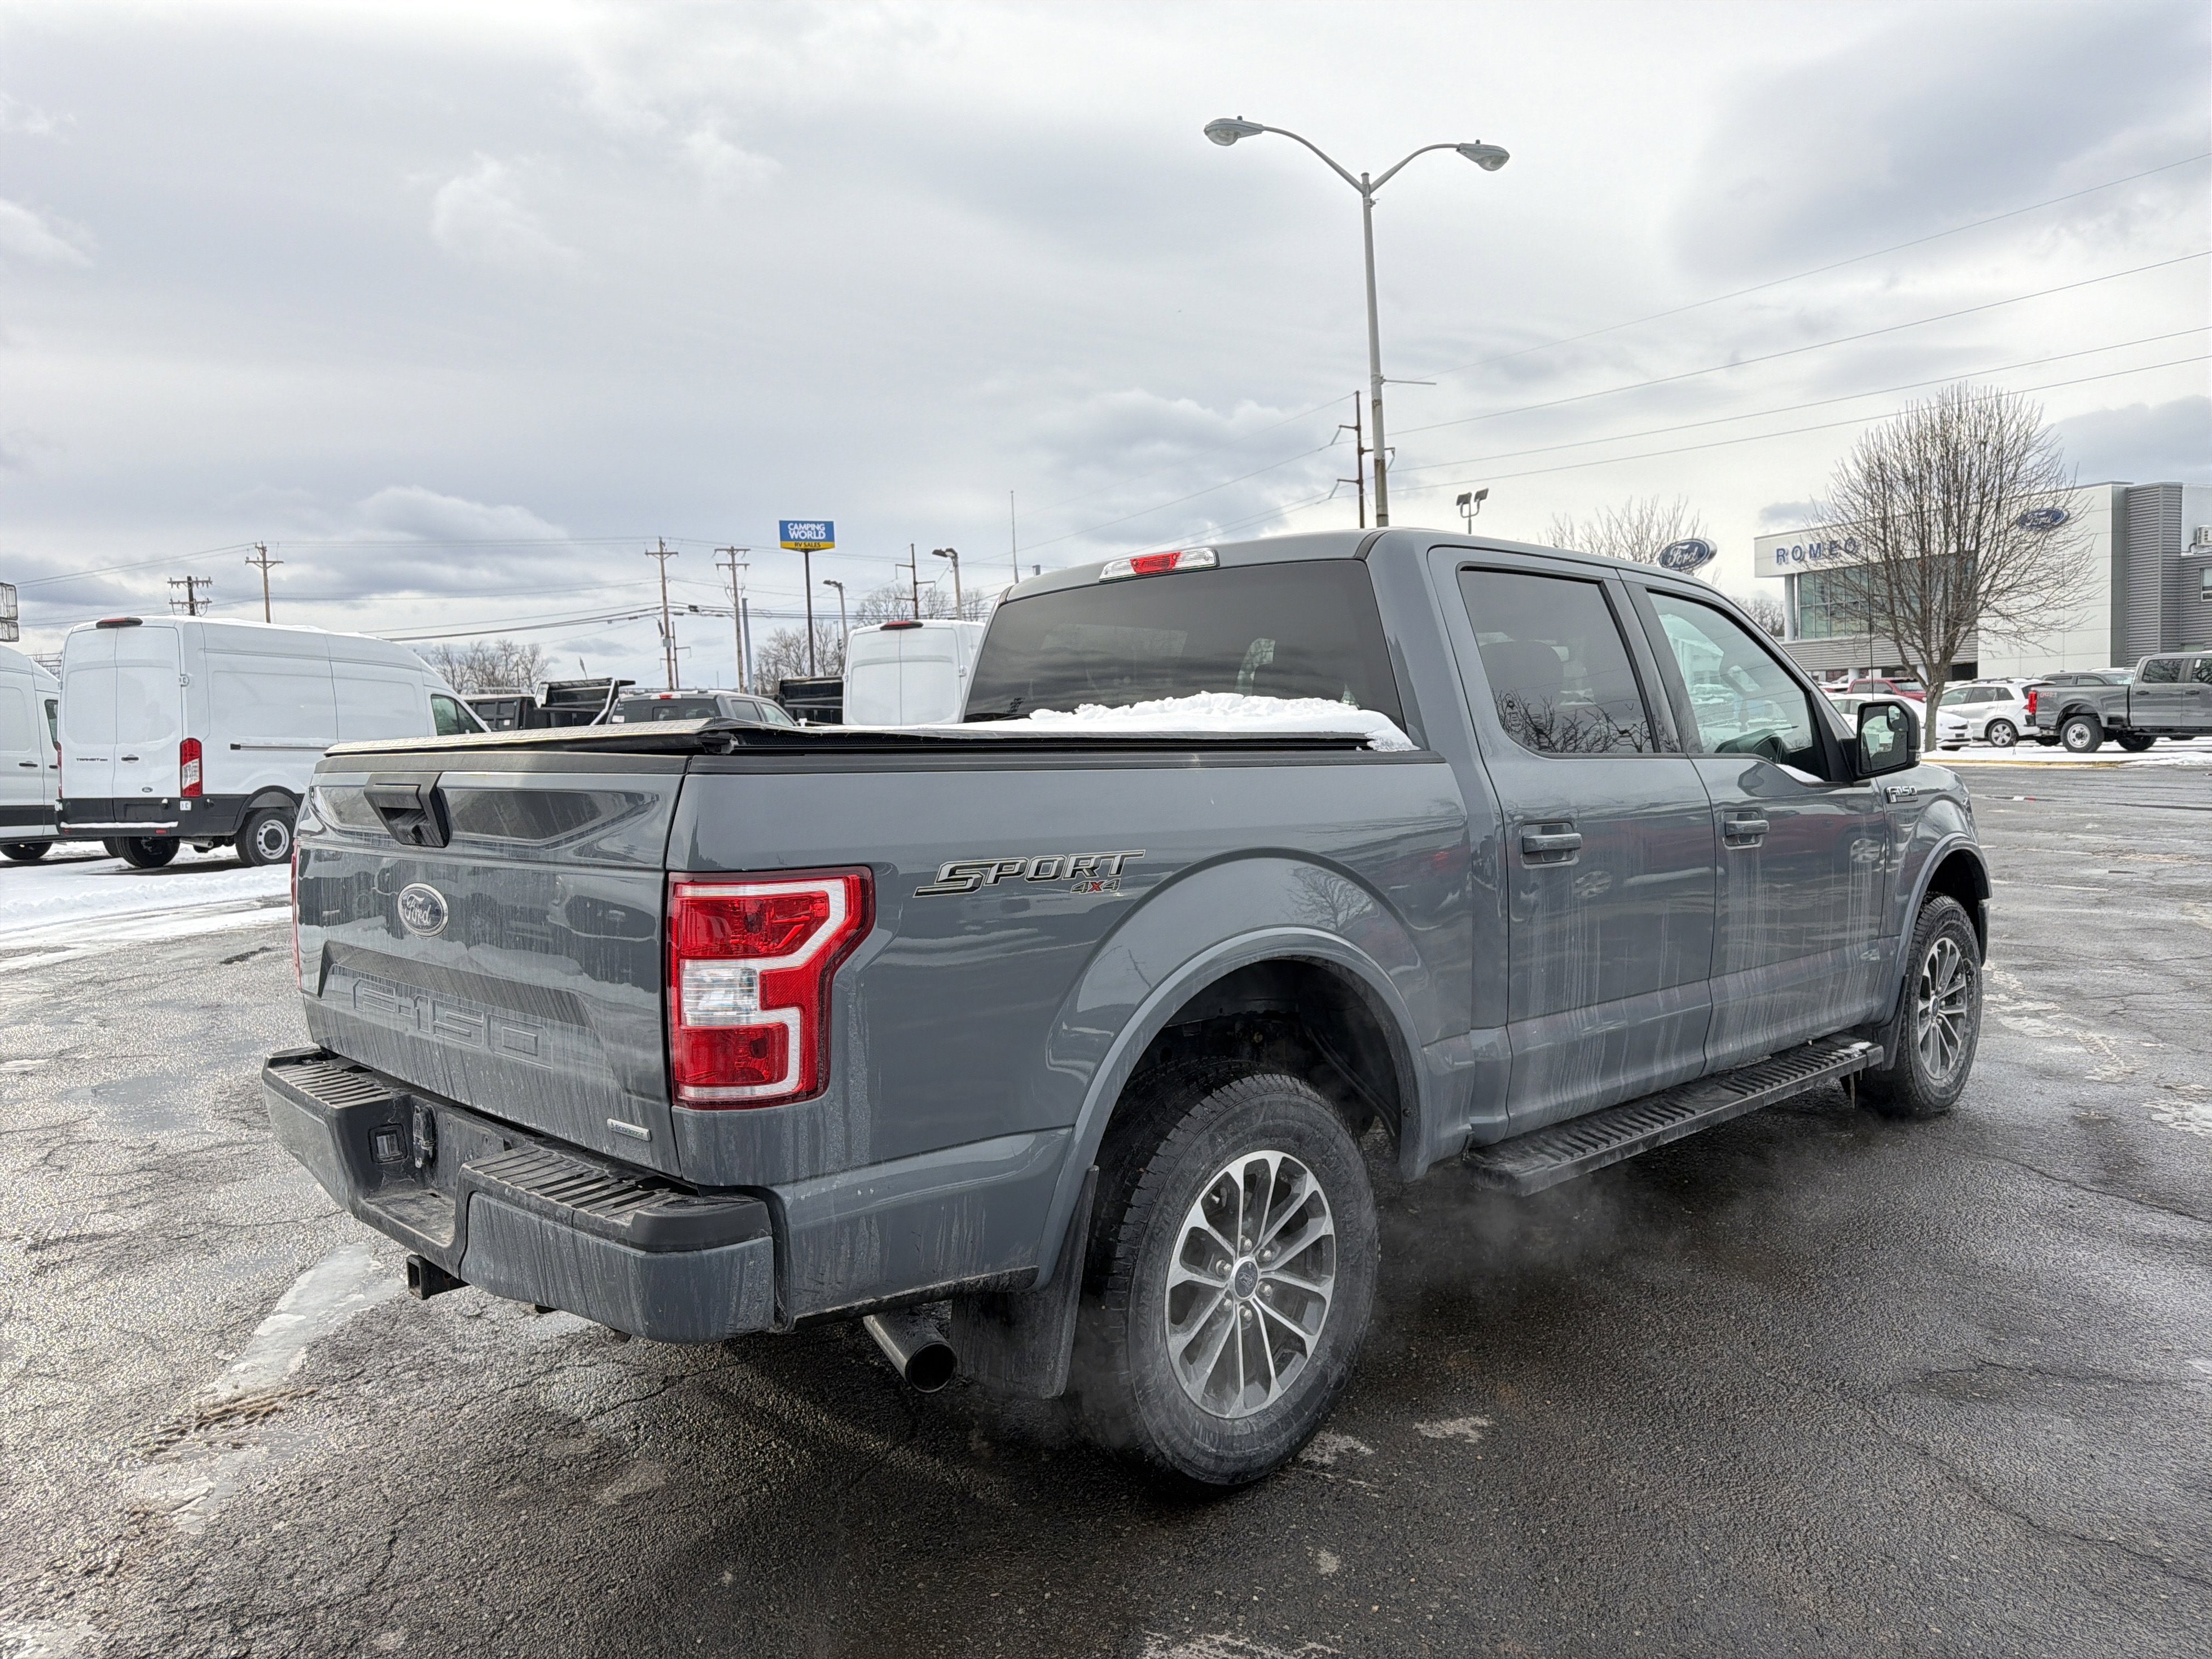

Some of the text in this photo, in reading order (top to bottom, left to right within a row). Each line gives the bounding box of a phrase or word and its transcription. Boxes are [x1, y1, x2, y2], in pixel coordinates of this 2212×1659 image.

[788, 523, 825, 531] CAMPING
[788, 530, 826, 539] WORLD
[1667, 544, 1699, 567] Ford
[1776, 537, 1857, 564] ROMEO
[913, 849, 1146, 898] SPORT
[405, 894, 432, 926] Ford
